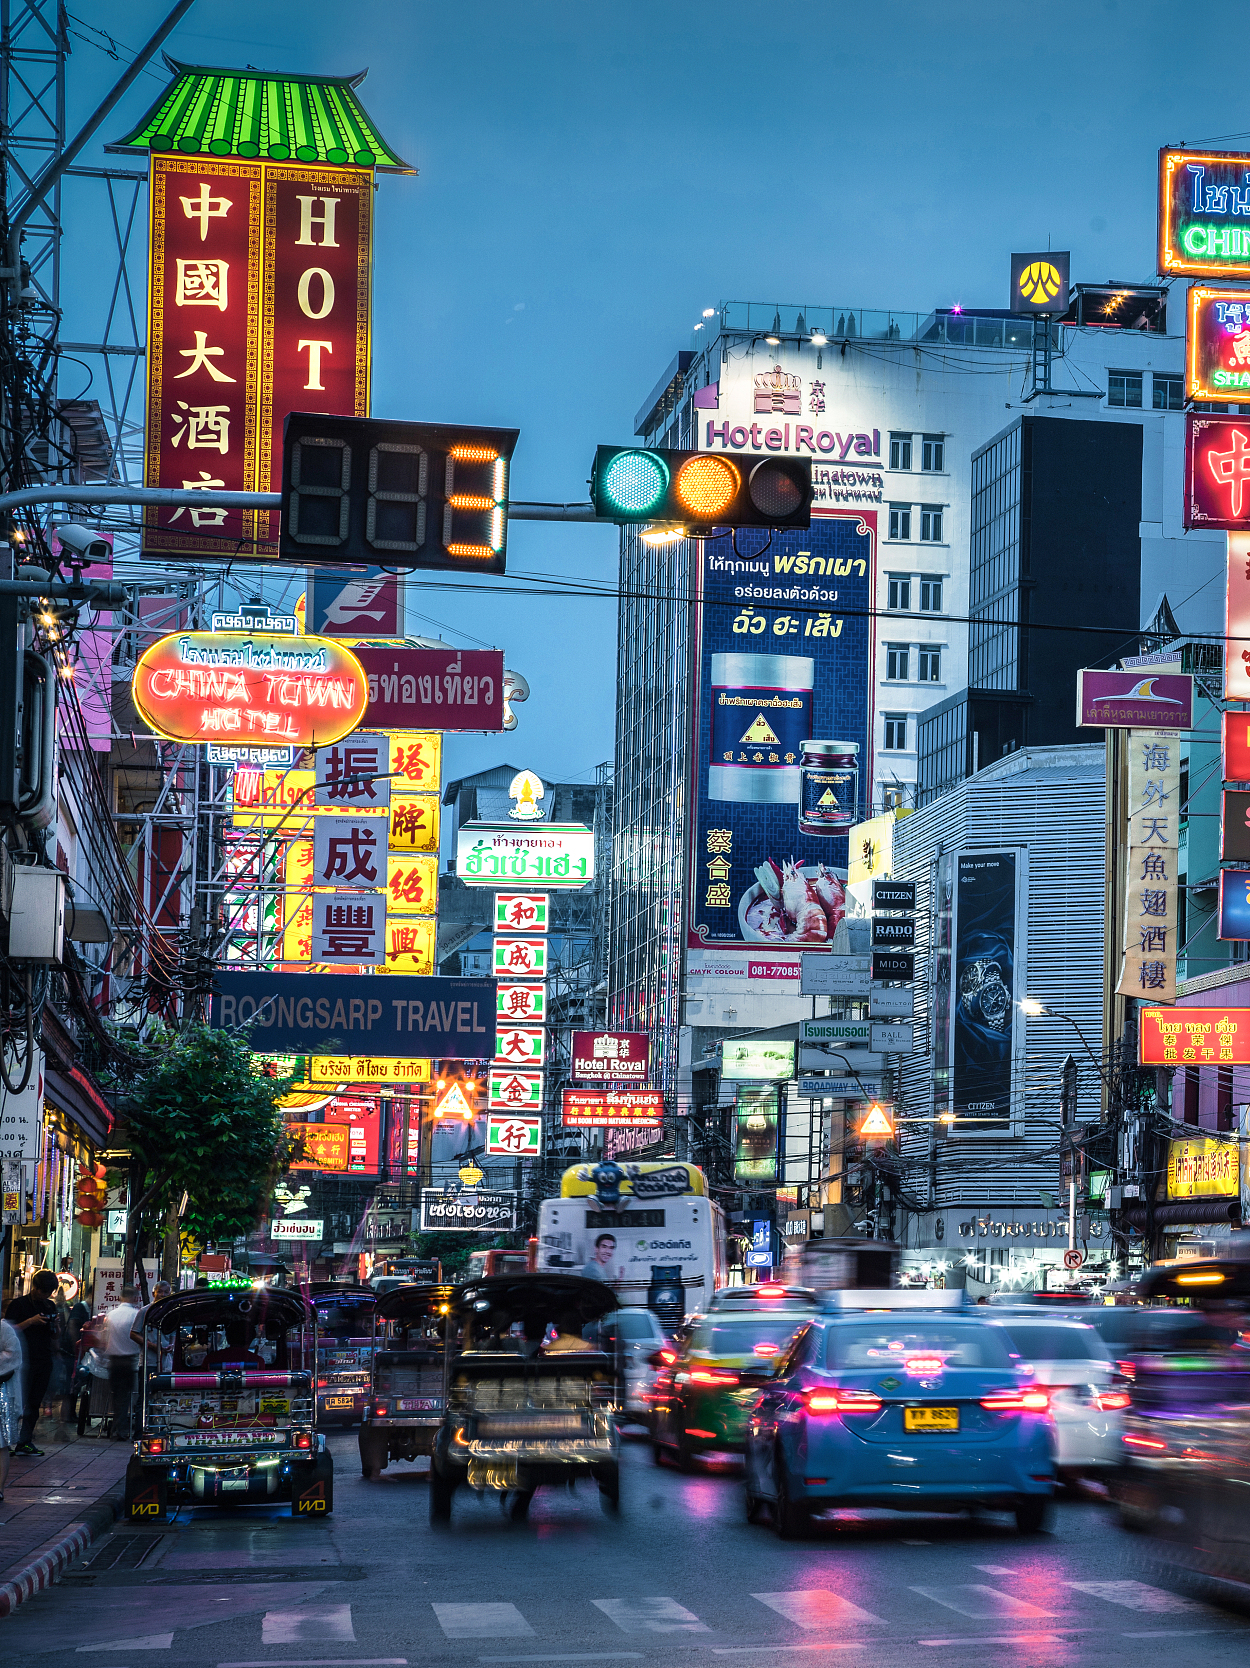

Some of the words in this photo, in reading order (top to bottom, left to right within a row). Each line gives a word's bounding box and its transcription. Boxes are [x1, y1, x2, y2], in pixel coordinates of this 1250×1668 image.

[294, 194, 341, 415] HOT
[167, 183, 237, 528] 中國大酒店
[707, 420, 790, 450] Hotel
[796, 425, 881, 459] Royal
[812, 466, 882, 485] inatown
[709, 556, 769, 576] ให้ทุกเมนู
[774, 551, 866, 576] พริกเผา
[734, 584, 838, 601] อร่อยลงตัวด้วย
[773, 616, 800, 635] ฮะ
[148, 669, 251, 702] CHINA
[261, 673, 355, 709] TOWN
[200, 708, 300, 737] HOTEL
[492, 834, 562, 848] ห้างขายทอง
[465, 839, 587, 877] ฮั่วเซ่งเฮง
[1138, 742, 1171, 991] 海外天魚翅酒樓
[706, 829, 732, 907] 蔡合盛
[876, 891, 912, 900] CITIZEN
[876, 926, 912, 934] RADO
[752, 966, 801, 976] 081-77085
[219, 995, 383, 1030] ROONGSARP
[392, 999, 486, 1034] TRAVEL
[501, 901, 536, 1150] 和成興大金行
[1156, 1018, 1182, 1033] ไทย
[1164, 1048, 1233, 1059] 批发干果
[320, 1060, 350, 1076] บริษัท
[356, 1059, 387, 1075] ดีไทย
[393, 1061, 422, 1077] จำกัด
[575, 1058, 608, 1070] Hotel
[611, 1059, 645, 1071] Royal
[803, 1082, 848, 1093] BROADWAY
[184, 1432, 276, 1446] THAILAND
[300, 1481, 325, 1499] 4
